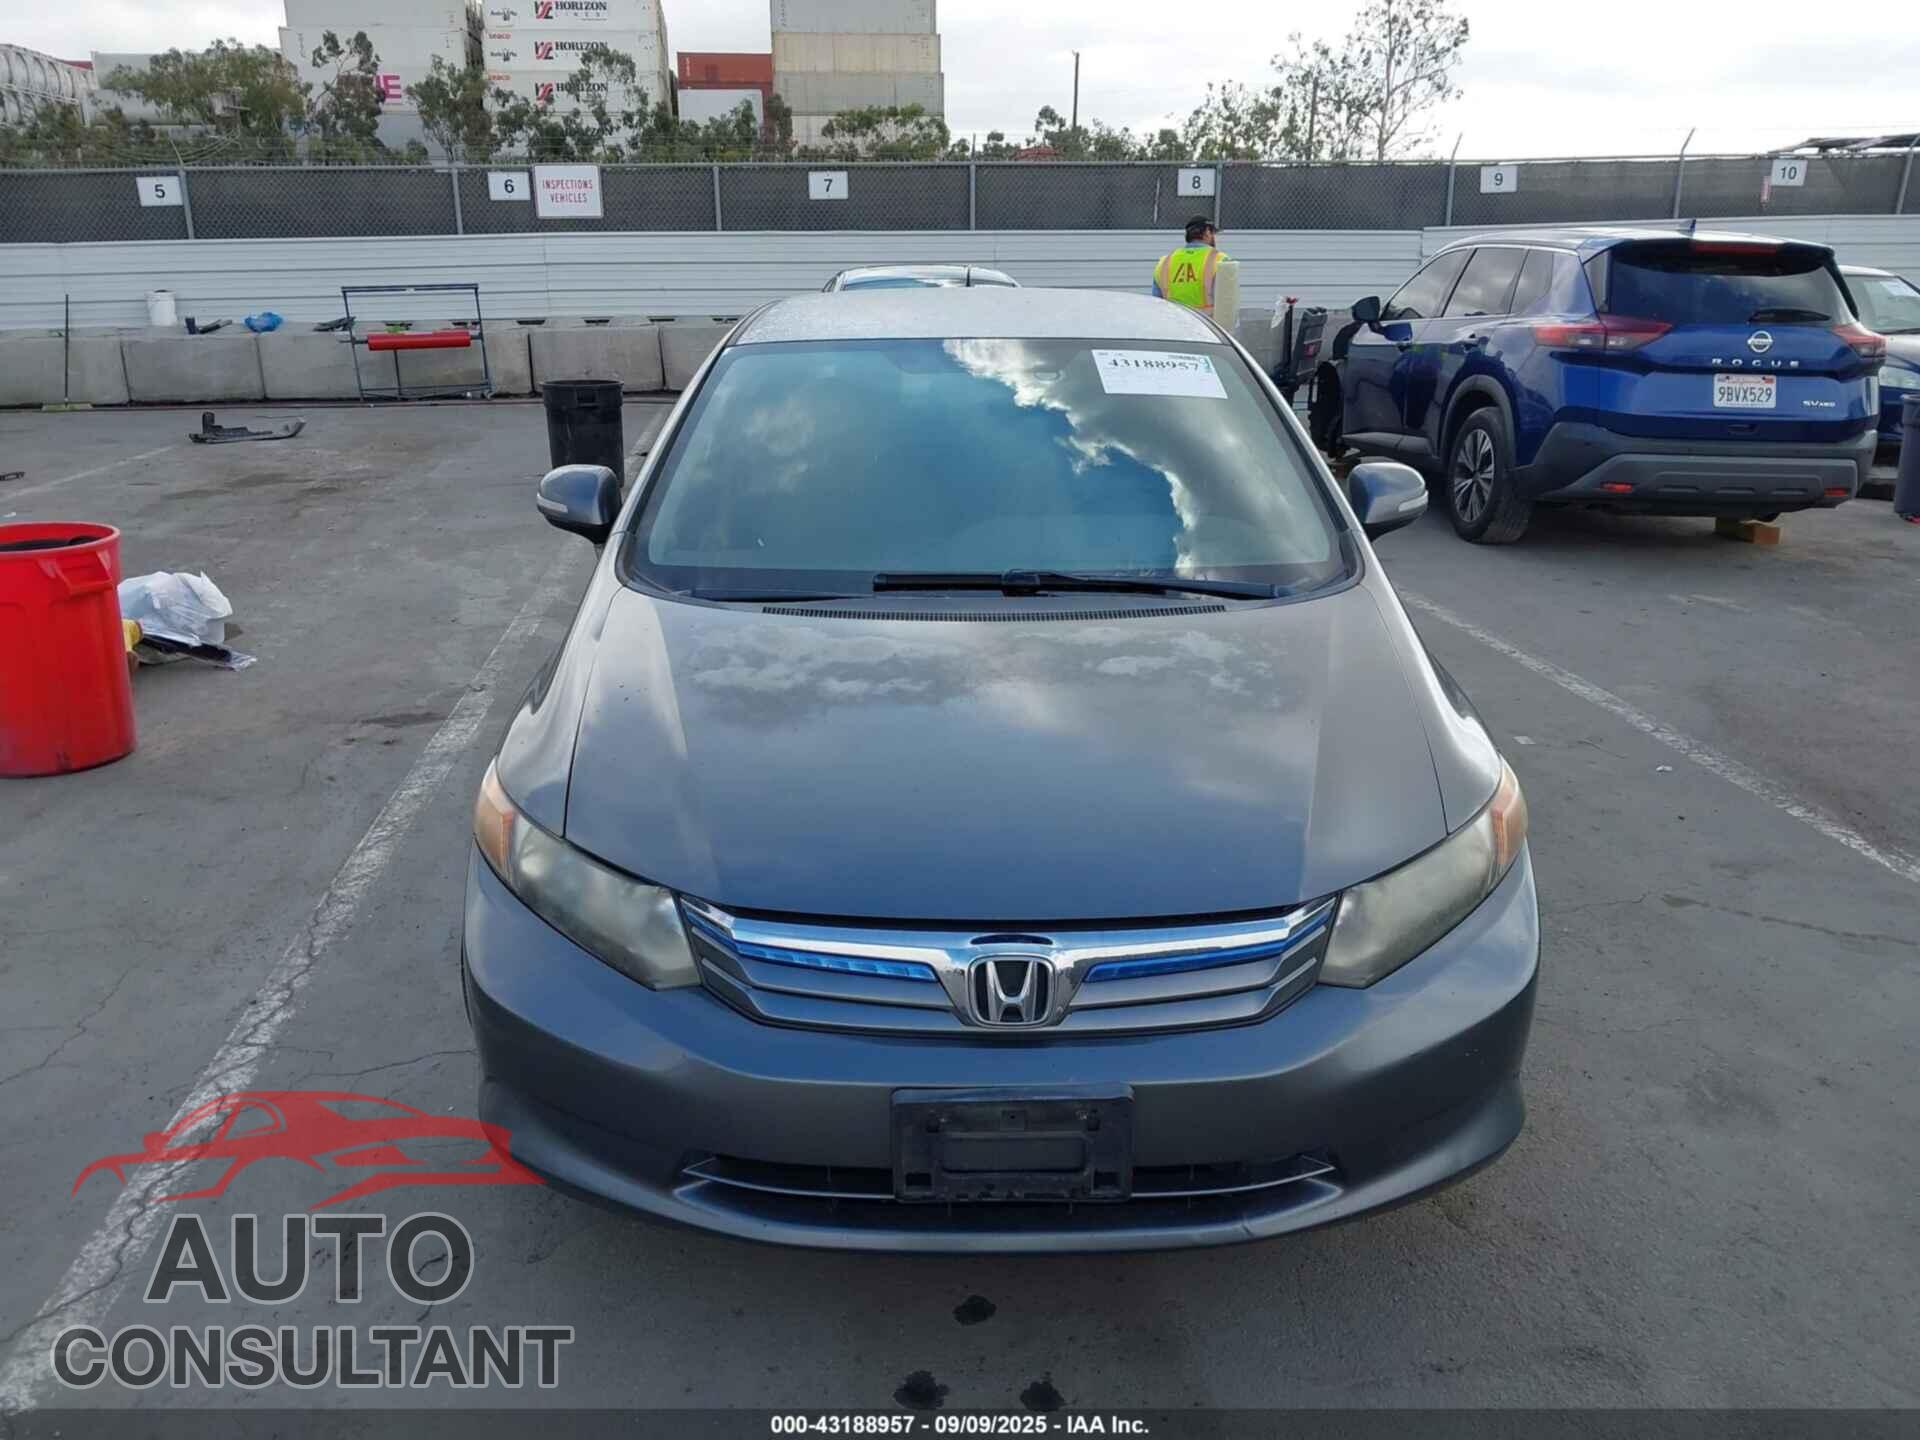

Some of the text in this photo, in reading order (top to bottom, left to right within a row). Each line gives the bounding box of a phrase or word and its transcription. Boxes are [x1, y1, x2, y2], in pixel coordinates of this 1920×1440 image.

[555, 1, 607, 11] HORIZON
[555, 41, 608, 51] HORIZON
[1494, 172, 1504, 186] 9
[1781, 166, 1798, 180] 10
[504, 179, 515, 194] 6
[542, 180, 593, 190] INSPECTIONS
[823, 178, 833, 193] 7
[1191, 175, 1201, 189] 8
[154, 183, 166, 199] 5
[550, 193, 588, 203] VEHICLES
[1711, 358, 1799, 368] ROGUE
[1718, 386, 1773, 403] 9BVX529
